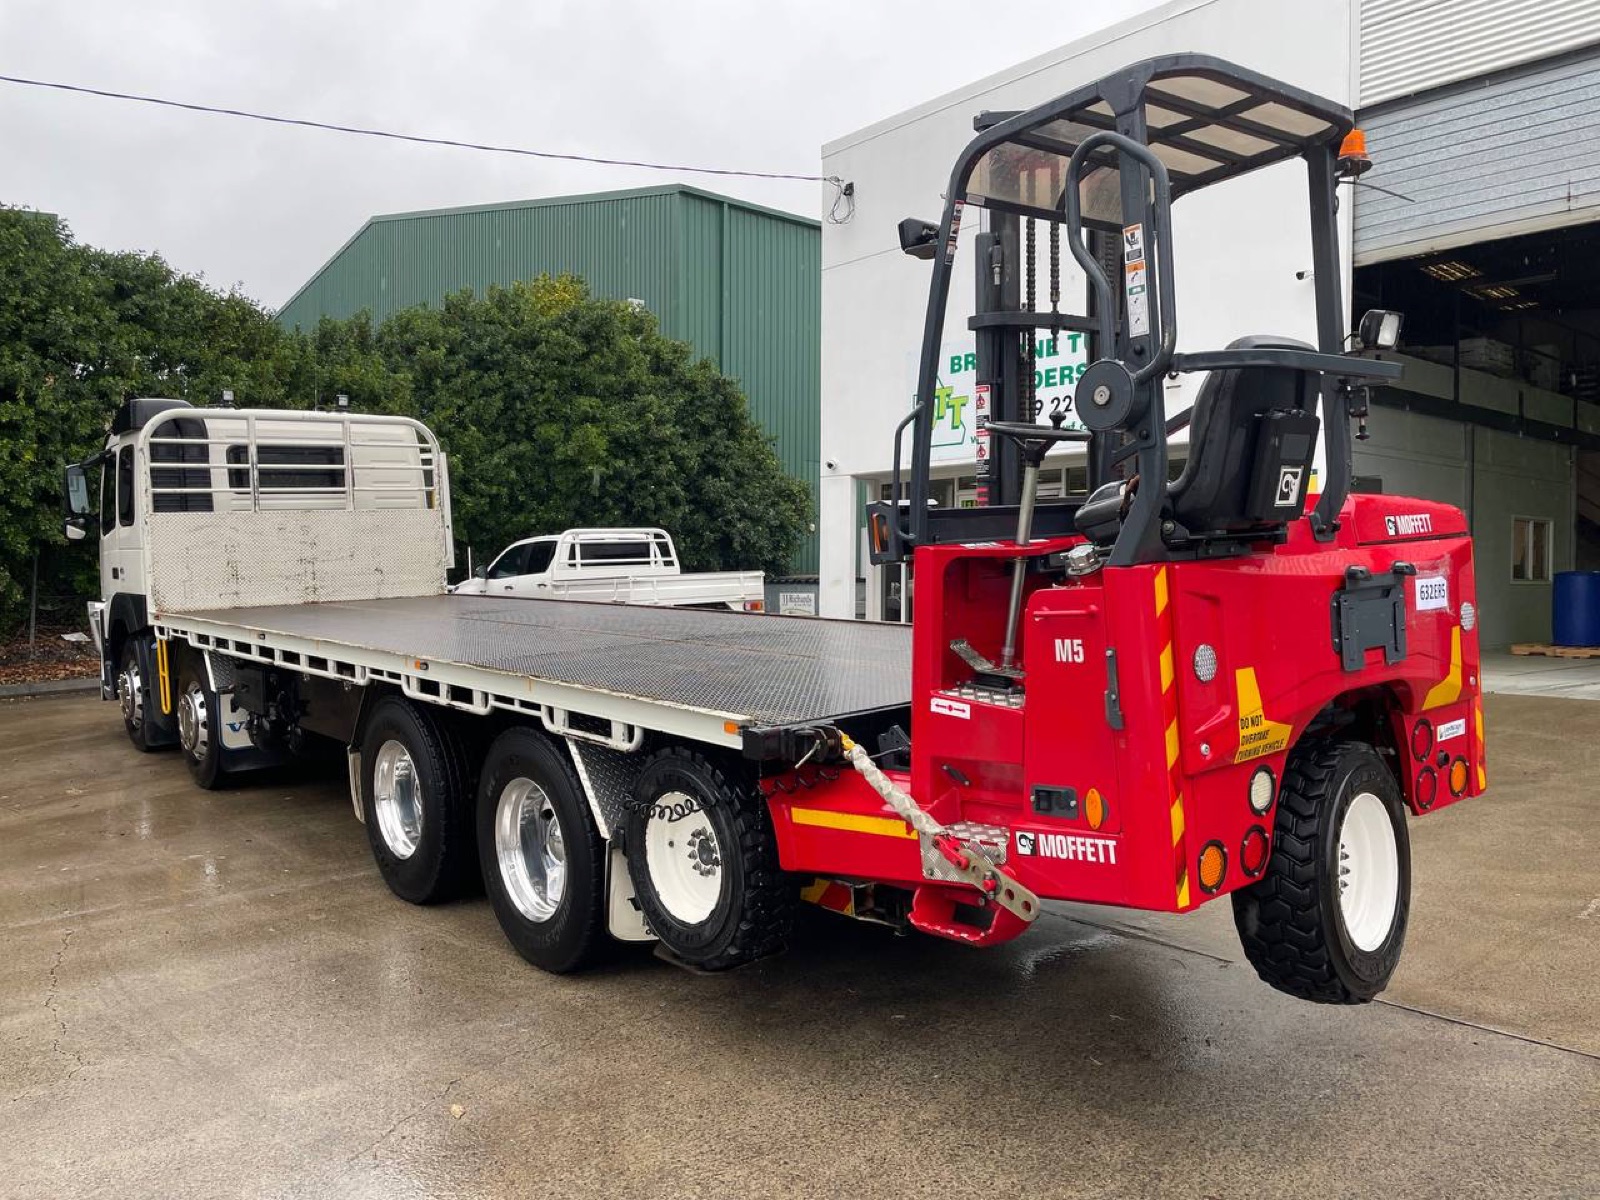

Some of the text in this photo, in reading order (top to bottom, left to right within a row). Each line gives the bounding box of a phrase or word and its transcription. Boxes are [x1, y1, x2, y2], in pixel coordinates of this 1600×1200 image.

[1396, 514, 1432, 535] MOFFETT
[1054, 638, 1085, 664] M5
[1240, 714, 1262, 730] DO NOT
[1241, 730, 1270, 746] OVERTAKE
[1261, 738, 1285, 753] VEHICLE
[1037, 833, 1117, 865] MOFFETT
